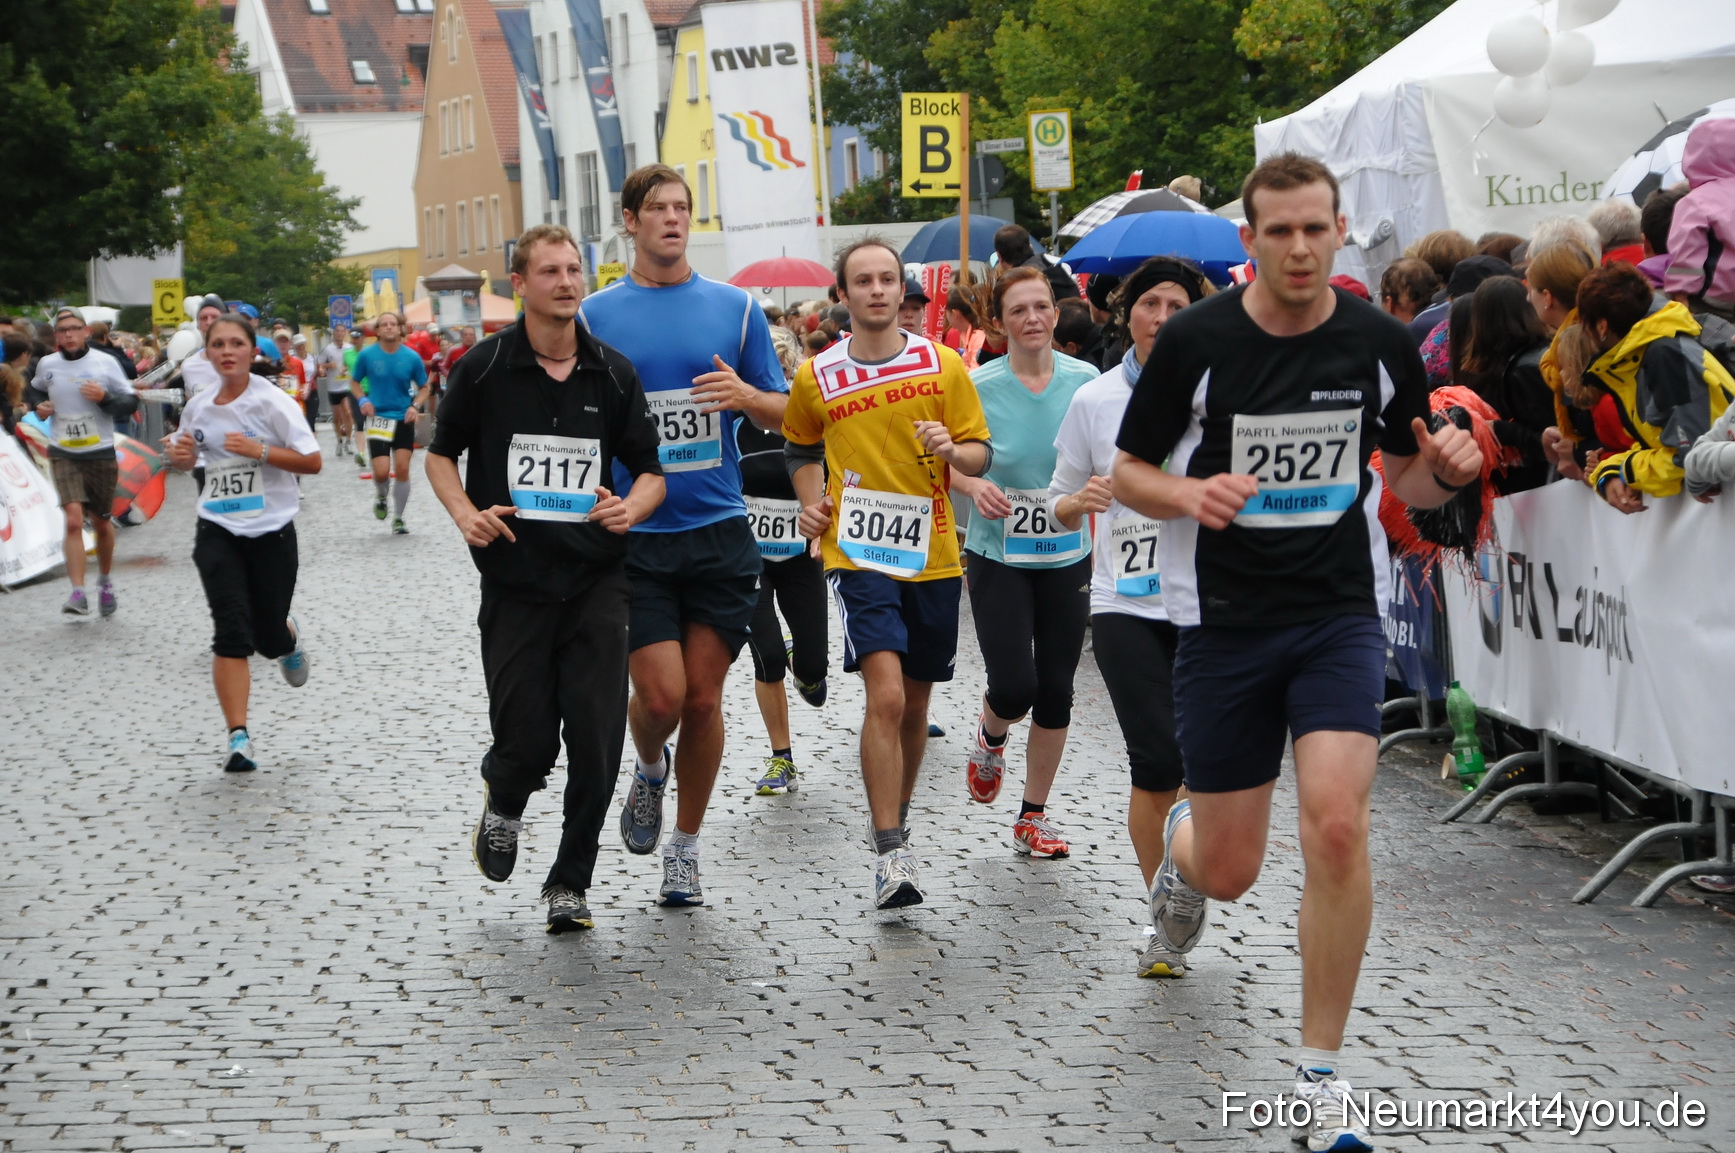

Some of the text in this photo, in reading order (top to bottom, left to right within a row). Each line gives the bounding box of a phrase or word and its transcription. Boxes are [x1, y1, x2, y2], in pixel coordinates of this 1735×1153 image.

[910, 98, 961, 116] Block
[919, 125, 952, 173] B
[1485, 171, 1604, 207] Kinder
[155, 280, 178, 289] Block
[159, 291, 175, 314] C
[828, 381, 944, 423] MAX BÖGL
[66, 421, 87, 437] 441
[371, 418, 389, 429] 139
[1236, 424, 1338, 438] PARTL Neumarkt
[510, 442, 586, 455] PARTL Neumarkt
[668, 448, 697, 461] Peter
[1247, 438, 1348, 483] 2527
[517, 455, 592, 489] 2117
[210, 471, 255, 498] 2457
[534, 495, 572, 509] Tobias
[843, 496, 917, 513] PARTL Neumarkt
[1007, 494, 1034, 503] PARTL
[1262, 494, 1328, 510] Andreas
[222, 502, 241, 512] Lisa
[763, 505, 795, 513] Neumarkt
[847, 509, 921, 547] 3044
[1112, 525, 1140, 537] PARTL
[1035, 541, 1057, 552] Rita
[863, 549, 899, 564] Stefan
